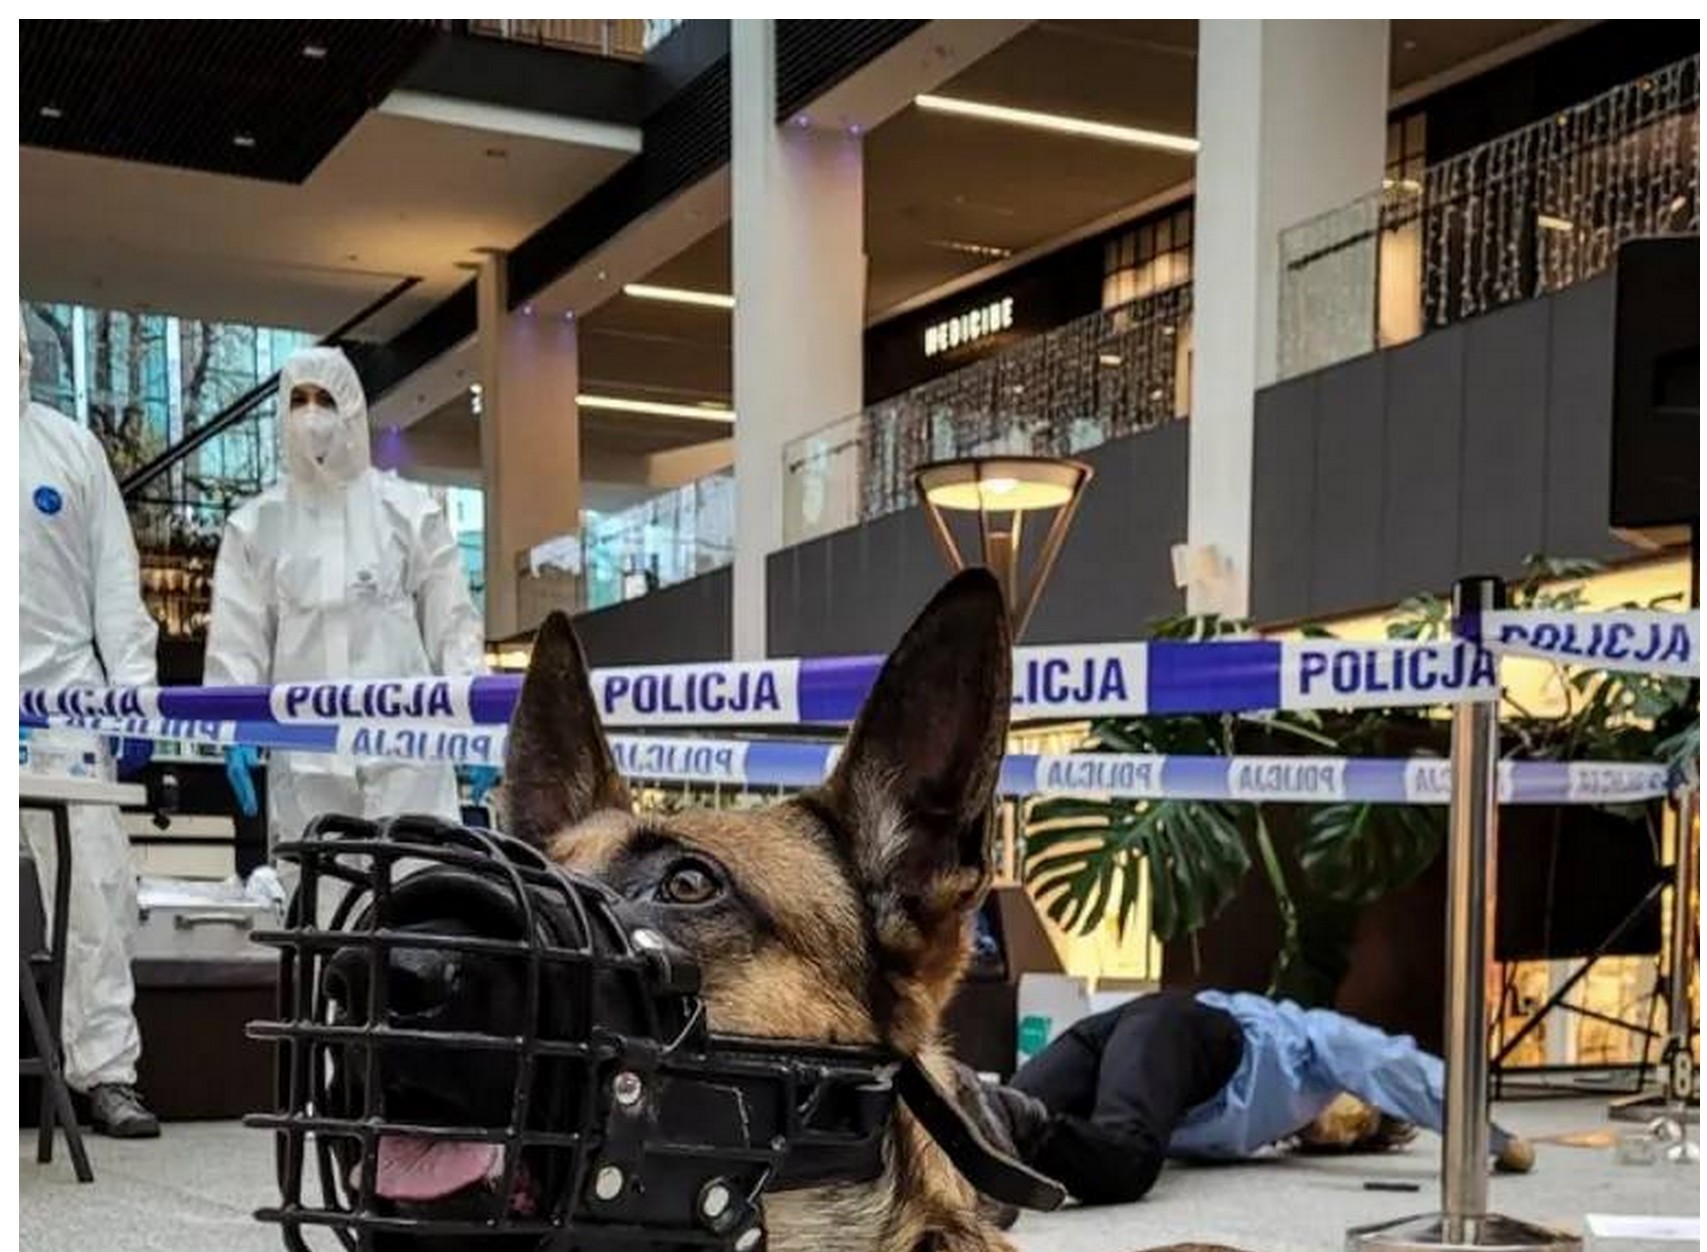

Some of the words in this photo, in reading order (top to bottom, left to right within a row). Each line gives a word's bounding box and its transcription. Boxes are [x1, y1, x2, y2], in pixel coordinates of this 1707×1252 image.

[1300, 644, 1496, 693] POLICJA
[285, 682, 453, 718] POLICJA
[604, 671, 780, 714] POLICJA
